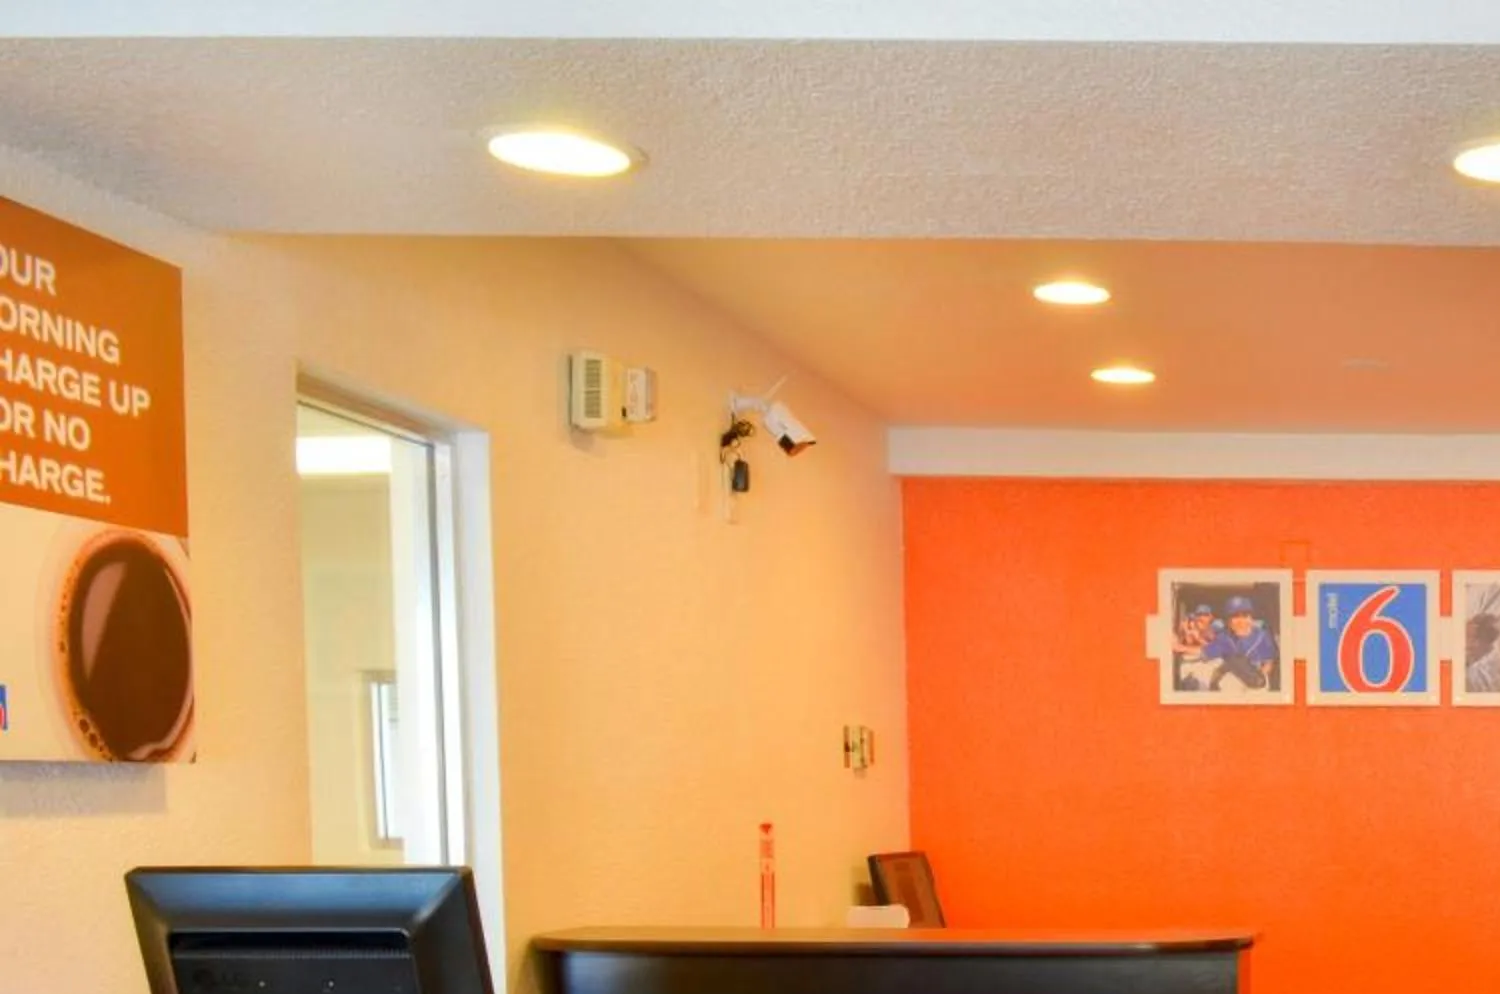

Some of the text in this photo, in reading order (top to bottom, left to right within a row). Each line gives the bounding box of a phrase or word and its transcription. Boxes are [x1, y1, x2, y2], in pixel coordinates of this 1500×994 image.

[109, 379, 151, 418] UP
[43, 408, 91, 451] NO
[1337, 585, 1415, 694] 6
